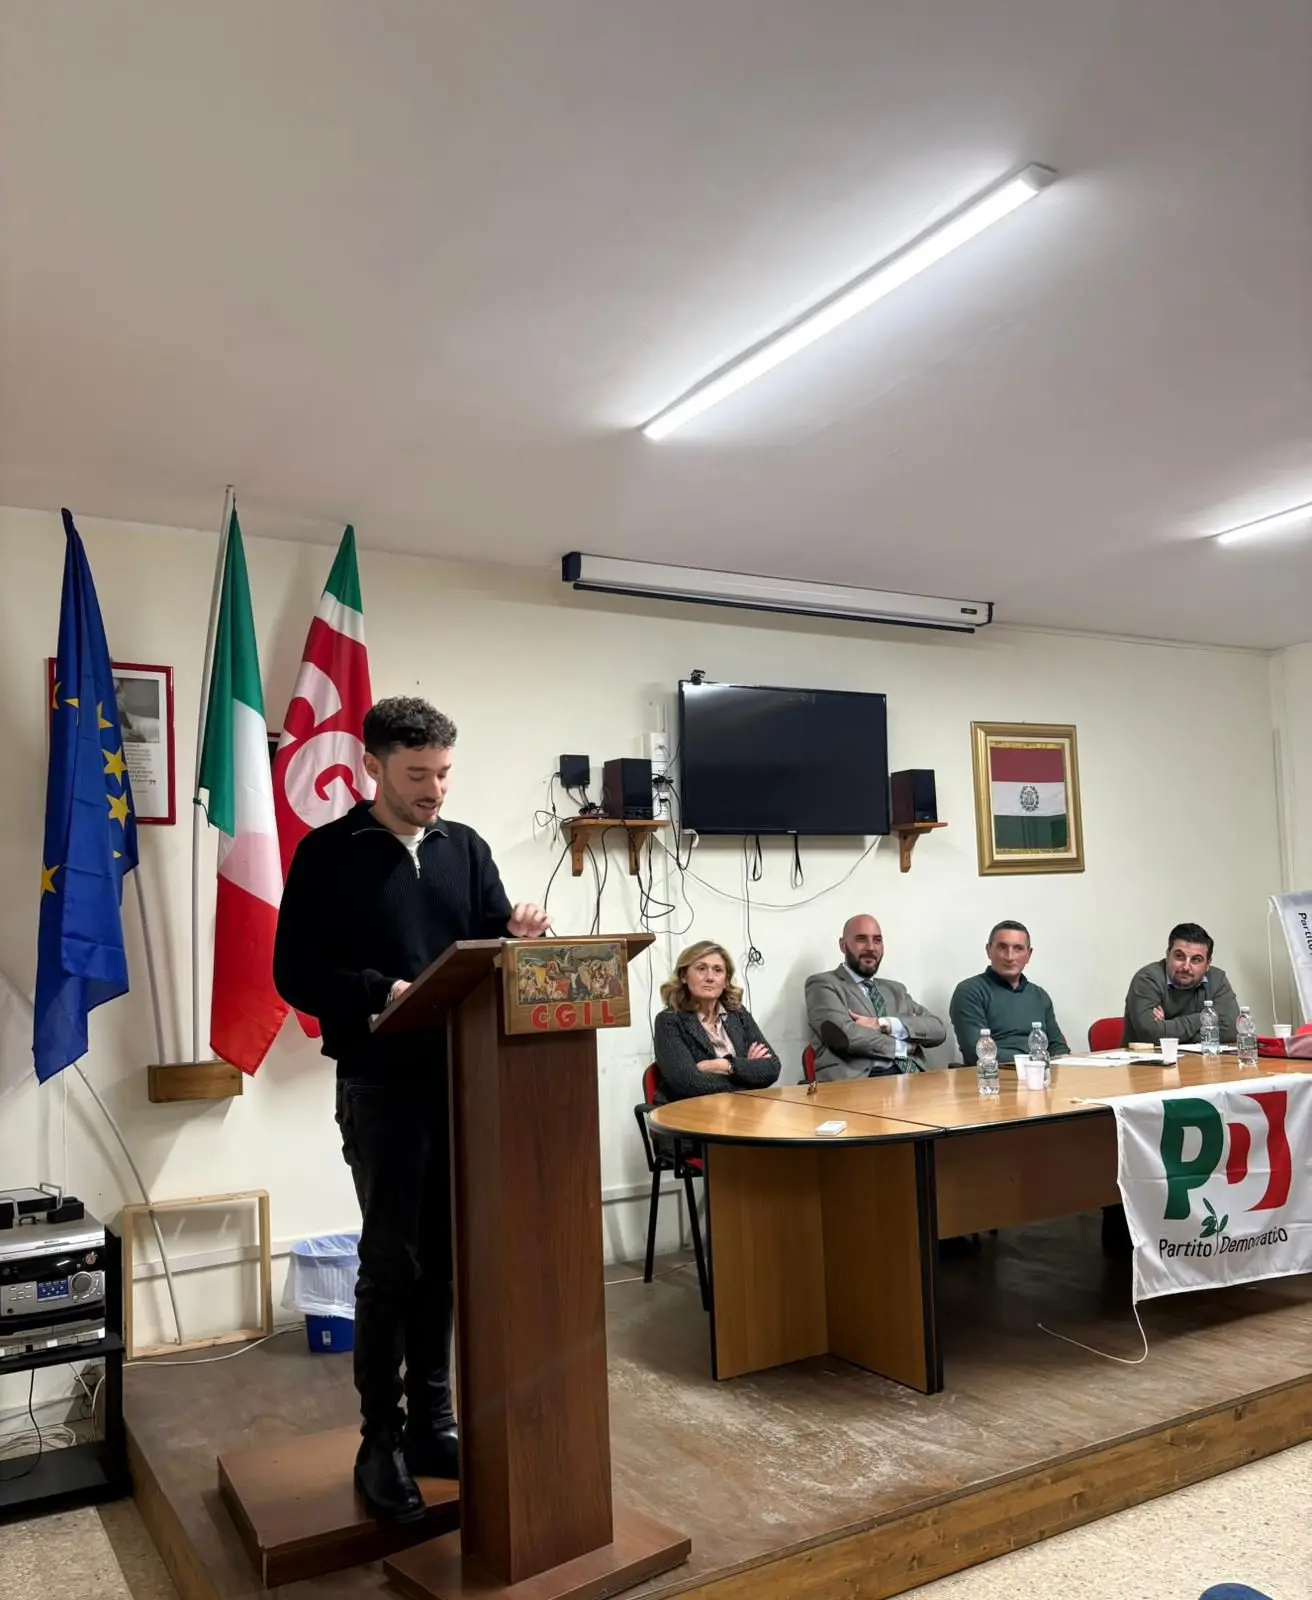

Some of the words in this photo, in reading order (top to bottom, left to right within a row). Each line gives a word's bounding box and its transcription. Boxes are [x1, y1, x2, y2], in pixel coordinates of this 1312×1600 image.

[531, 1001, 615, 1030] CGIL
[1160, 1090, 1292, 1220] PD
[1159, 1238, 1212, 1259] Partito
